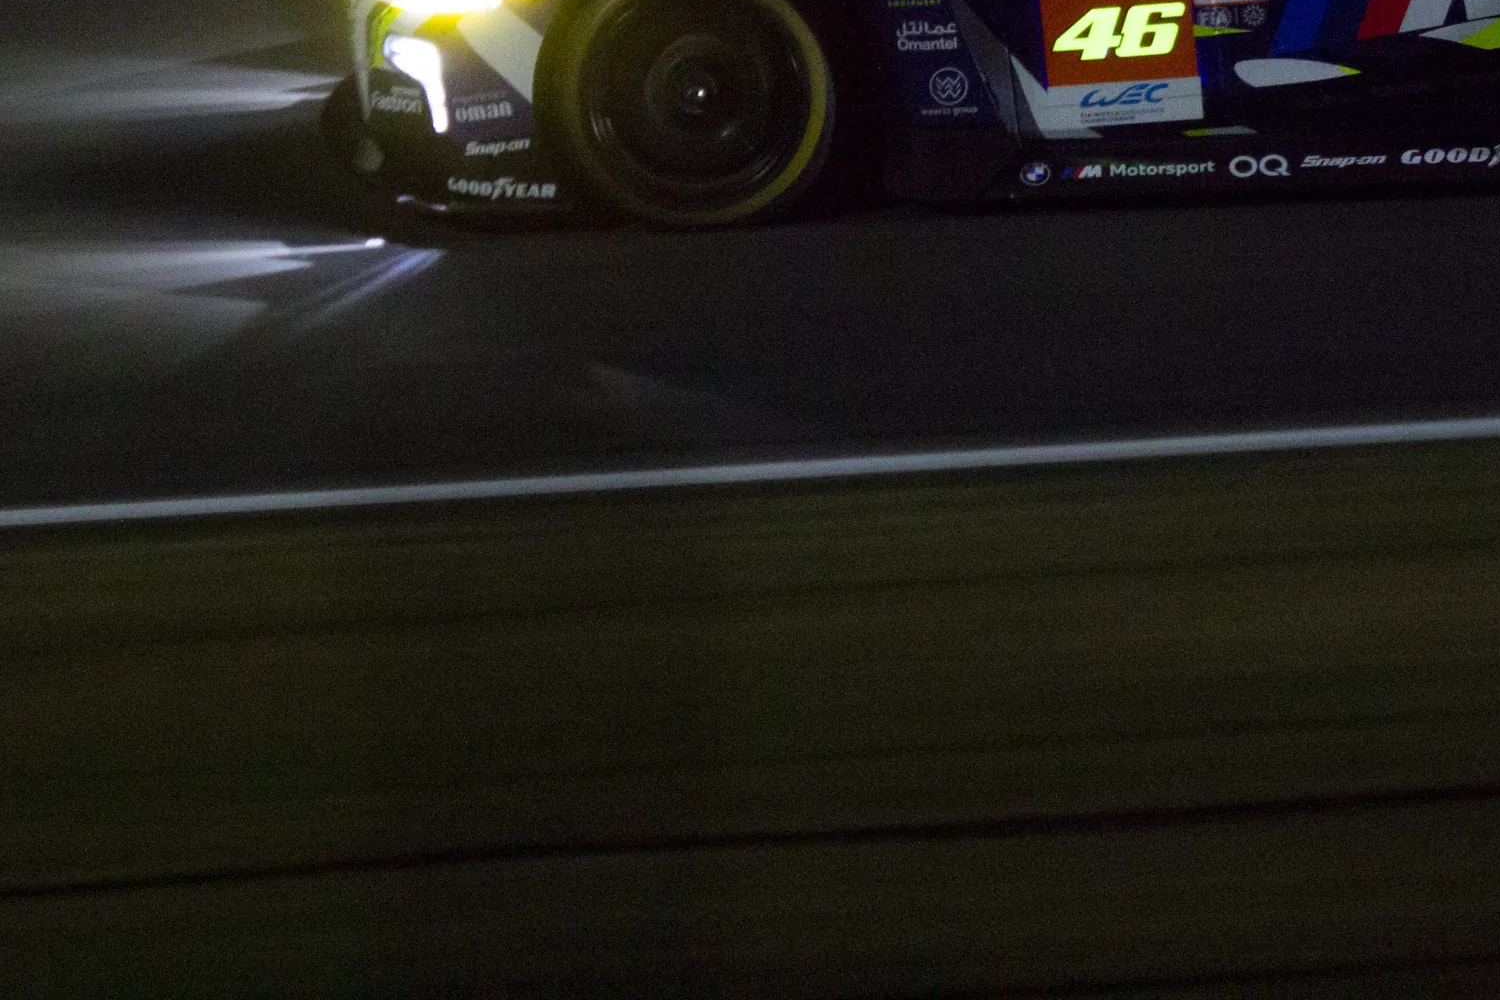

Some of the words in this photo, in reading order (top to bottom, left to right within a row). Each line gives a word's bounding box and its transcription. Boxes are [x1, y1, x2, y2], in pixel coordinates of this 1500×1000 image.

[1053, 2, 1186, 60] 46
[897, 36, 957, 50] Omantel
[455, 102, 513, 123] oman
[465, 139, 530, 157] Snap-on
[1110, 161, 1215, 178] Motorsport
[1229, 154, 1291, 178] OQ
[1300, 155, 1387, 168] Snap-on
